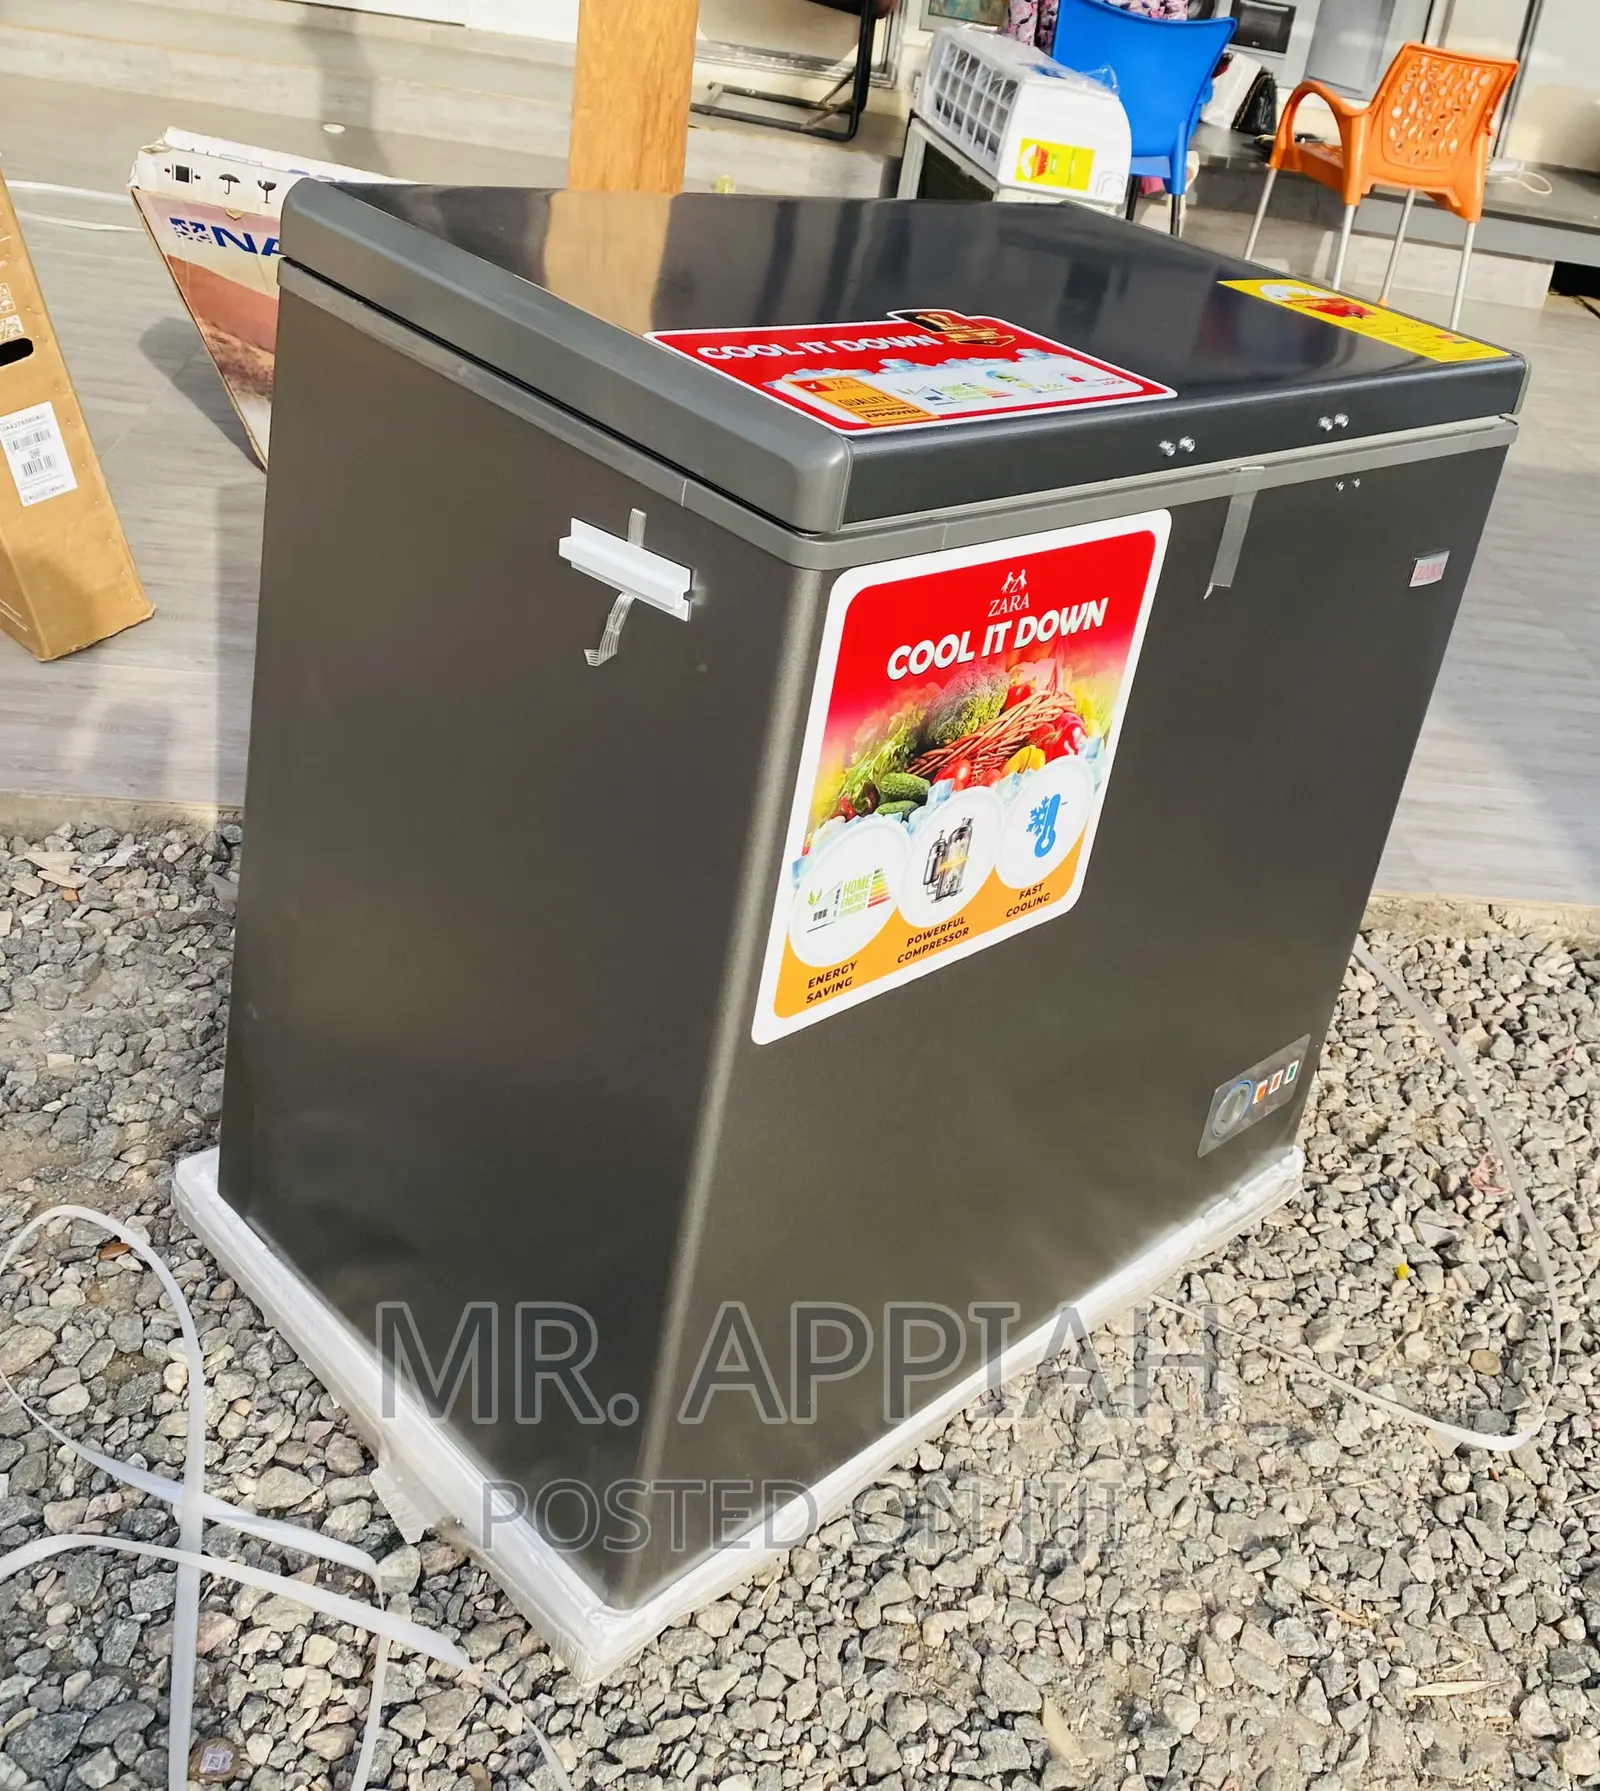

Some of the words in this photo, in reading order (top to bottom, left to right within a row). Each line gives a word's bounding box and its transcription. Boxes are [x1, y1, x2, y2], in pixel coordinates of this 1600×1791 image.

[697, 343, 805, 361] COOL
[798, 340, 837, 355] IT
[827, 334, 944, 352] DOWN
[838, 395, 893, 406] QUALITY
[865, 409, 922, 418] APPROVED
[988, 592, 1030, 617] ZARA
[886, 630, 976, 681] COOL
[981, 620, 1013, 658] IT
[1013, 597, 1110, 650] DOWN
[842, 874, 873, 895] HOME
[1018, 882, 1045, 901] FAST
[1005, 892, 1051, 918] COOLING
[896, 926, 971, 964] COMPRESSOR
[906, 916, 967, 948] POWERFUL
[807, 960, 859, 989] ENERGY
[806, 976, 854, 1004] SAVING
